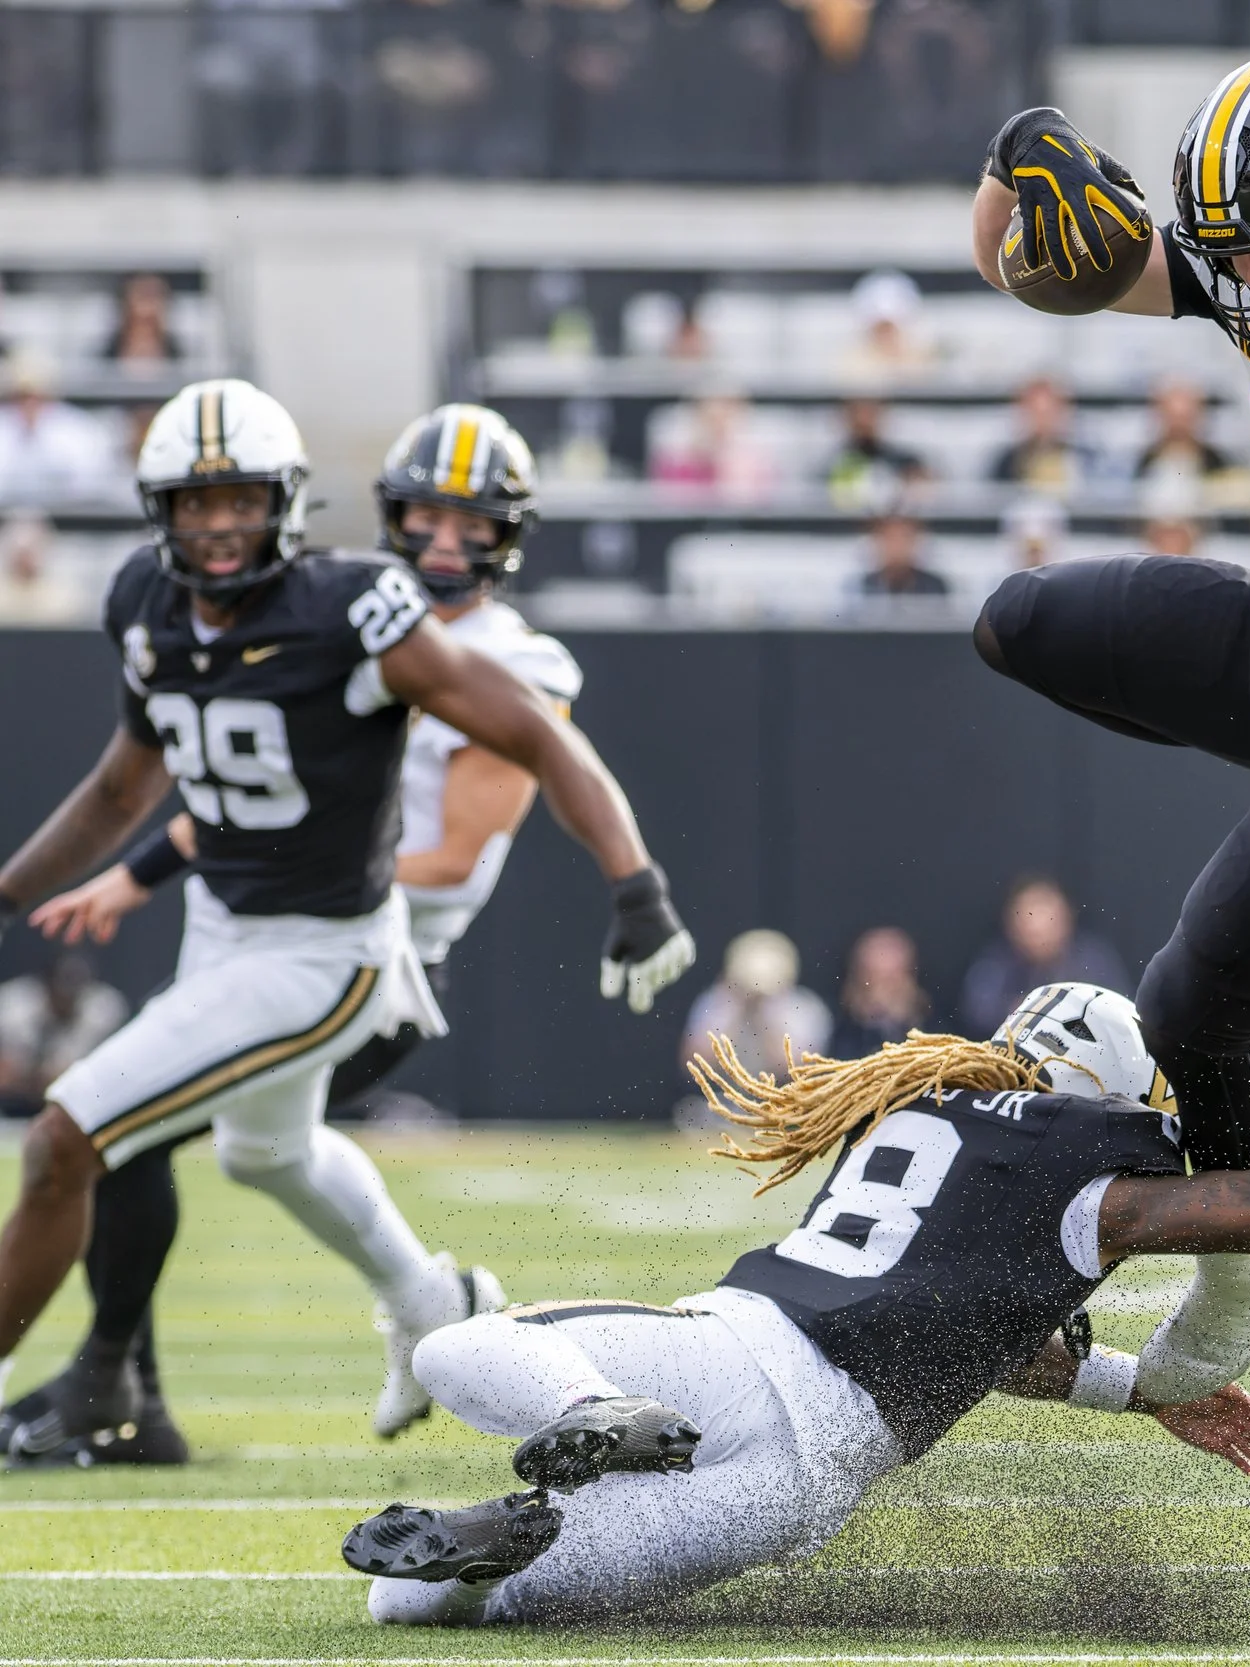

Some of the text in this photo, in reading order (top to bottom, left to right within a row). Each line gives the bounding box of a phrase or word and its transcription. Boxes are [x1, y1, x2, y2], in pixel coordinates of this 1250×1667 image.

[1198, 228, 1236, 238] MIZZOU
[347, 567, 427, 655] 29
[145, 692, 311, 830] 29
[972, 1090, 1039, 1121] JR
[775, 1110, 963, 1278] 8
